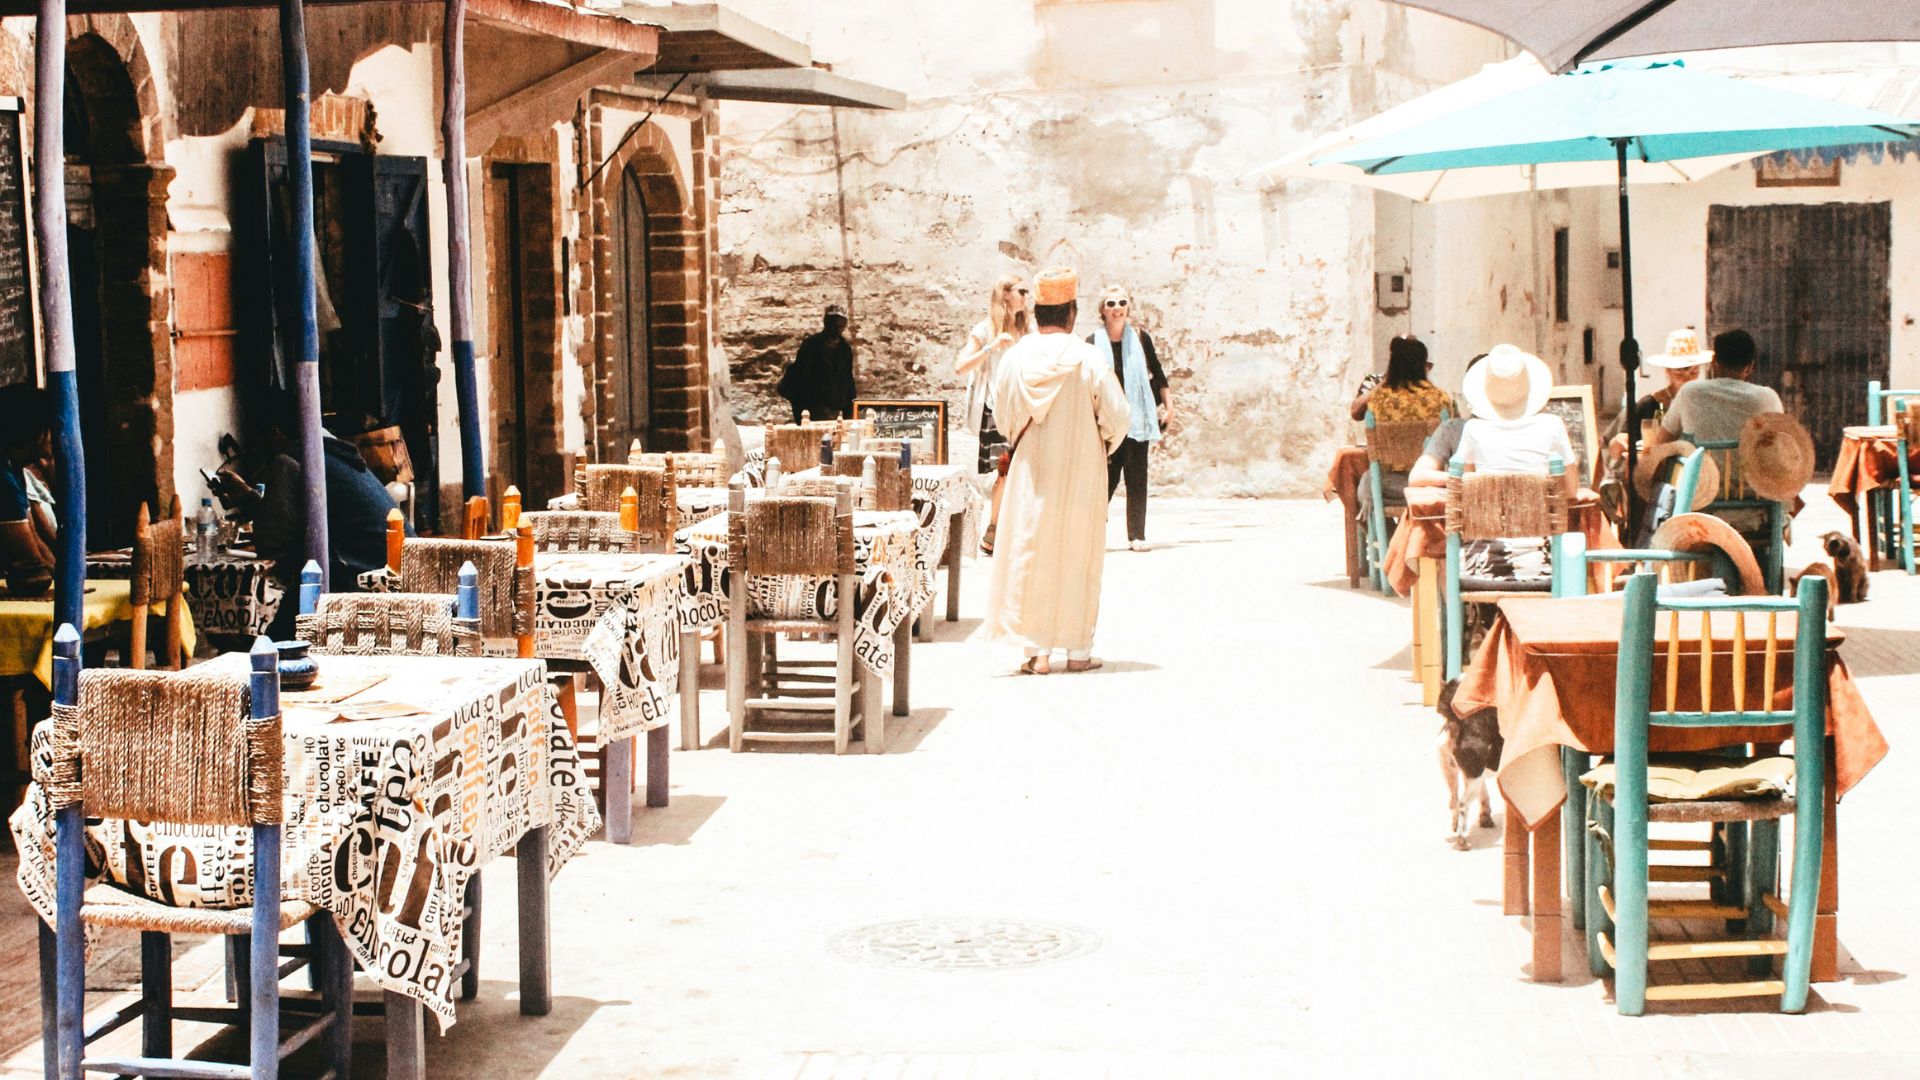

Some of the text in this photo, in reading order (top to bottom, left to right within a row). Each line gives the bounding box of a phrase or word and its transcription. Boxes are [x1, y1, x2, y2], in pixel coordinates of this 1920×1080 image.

[303, 737, 315, 754] HO
[462, 723, 485, 834] coffee
[307, 848, 320, 892] coffee
[320, 818, 333, 909] HOCOLATE
[335, 893, 357, 916] HOT
